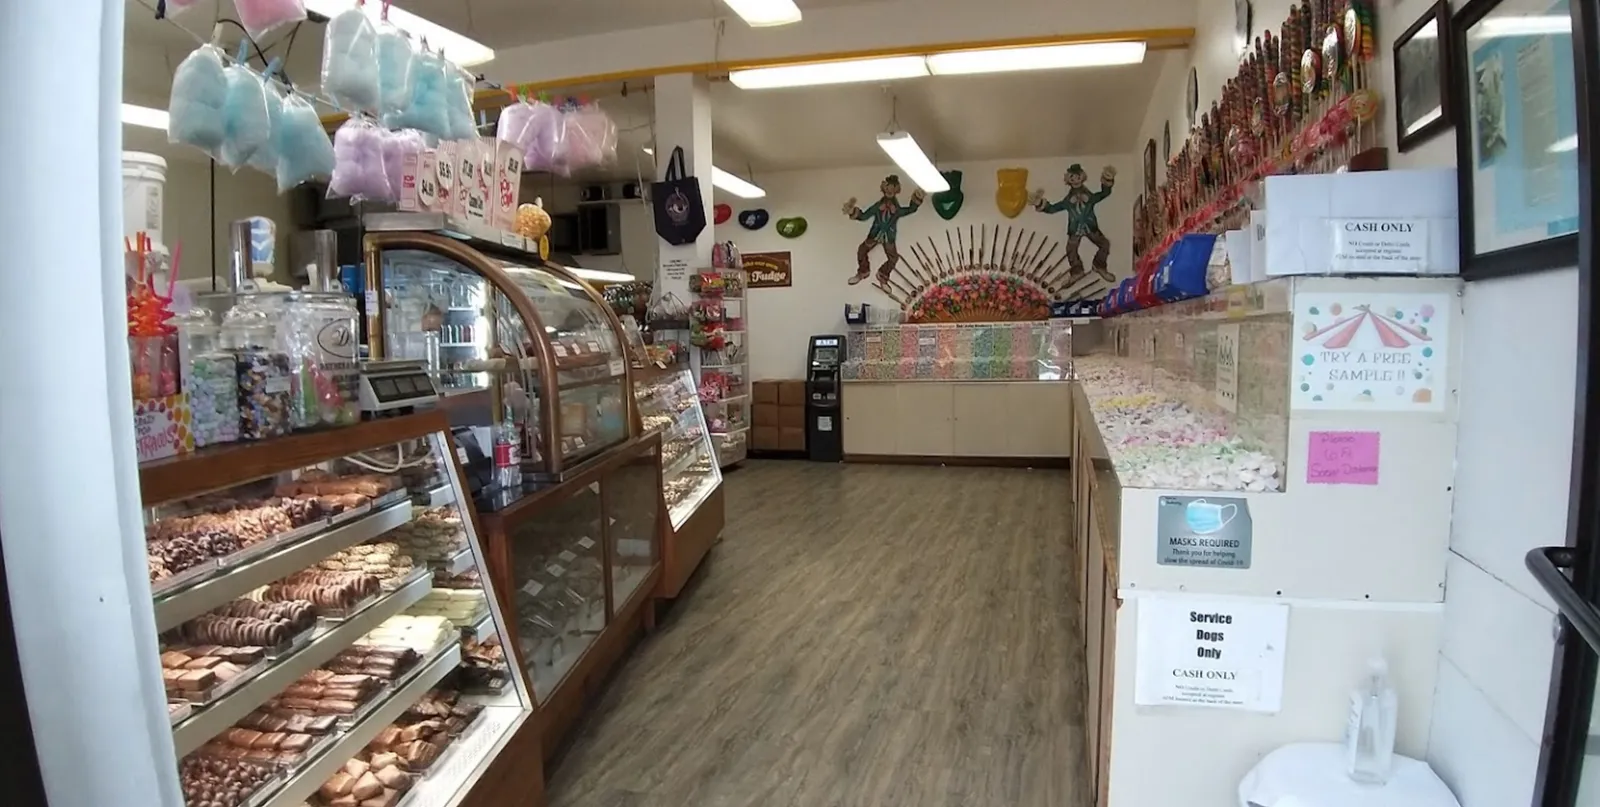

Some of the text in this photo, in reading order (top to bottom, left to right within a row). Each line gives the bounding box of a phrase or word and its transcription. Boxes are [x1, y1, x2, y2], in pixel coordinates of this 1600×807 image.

[1345, 222, 1415, 233] CASH ONLY
[751, 270, 786, 283] Fudge
[1320, 351, 1412, 364] TRY A FREE
[1329, 368, 1393, 382] SAMPLE
[1169, 537, 1241, 548] MASKS REQUIRED
[1172, 548, 1190, 556] Thank
[1190, 549, 1203, 557] you
[1213, 549, 1237, 558] helping
[1189, 557, 1210, 566] spread
[1190, 611, 1233, 625] Service
[1196, 629, 1225, 642] Dogs
[1197, 646, 1222, 660] Only
[1172, 668, 1238, 680] CASH ONLY
